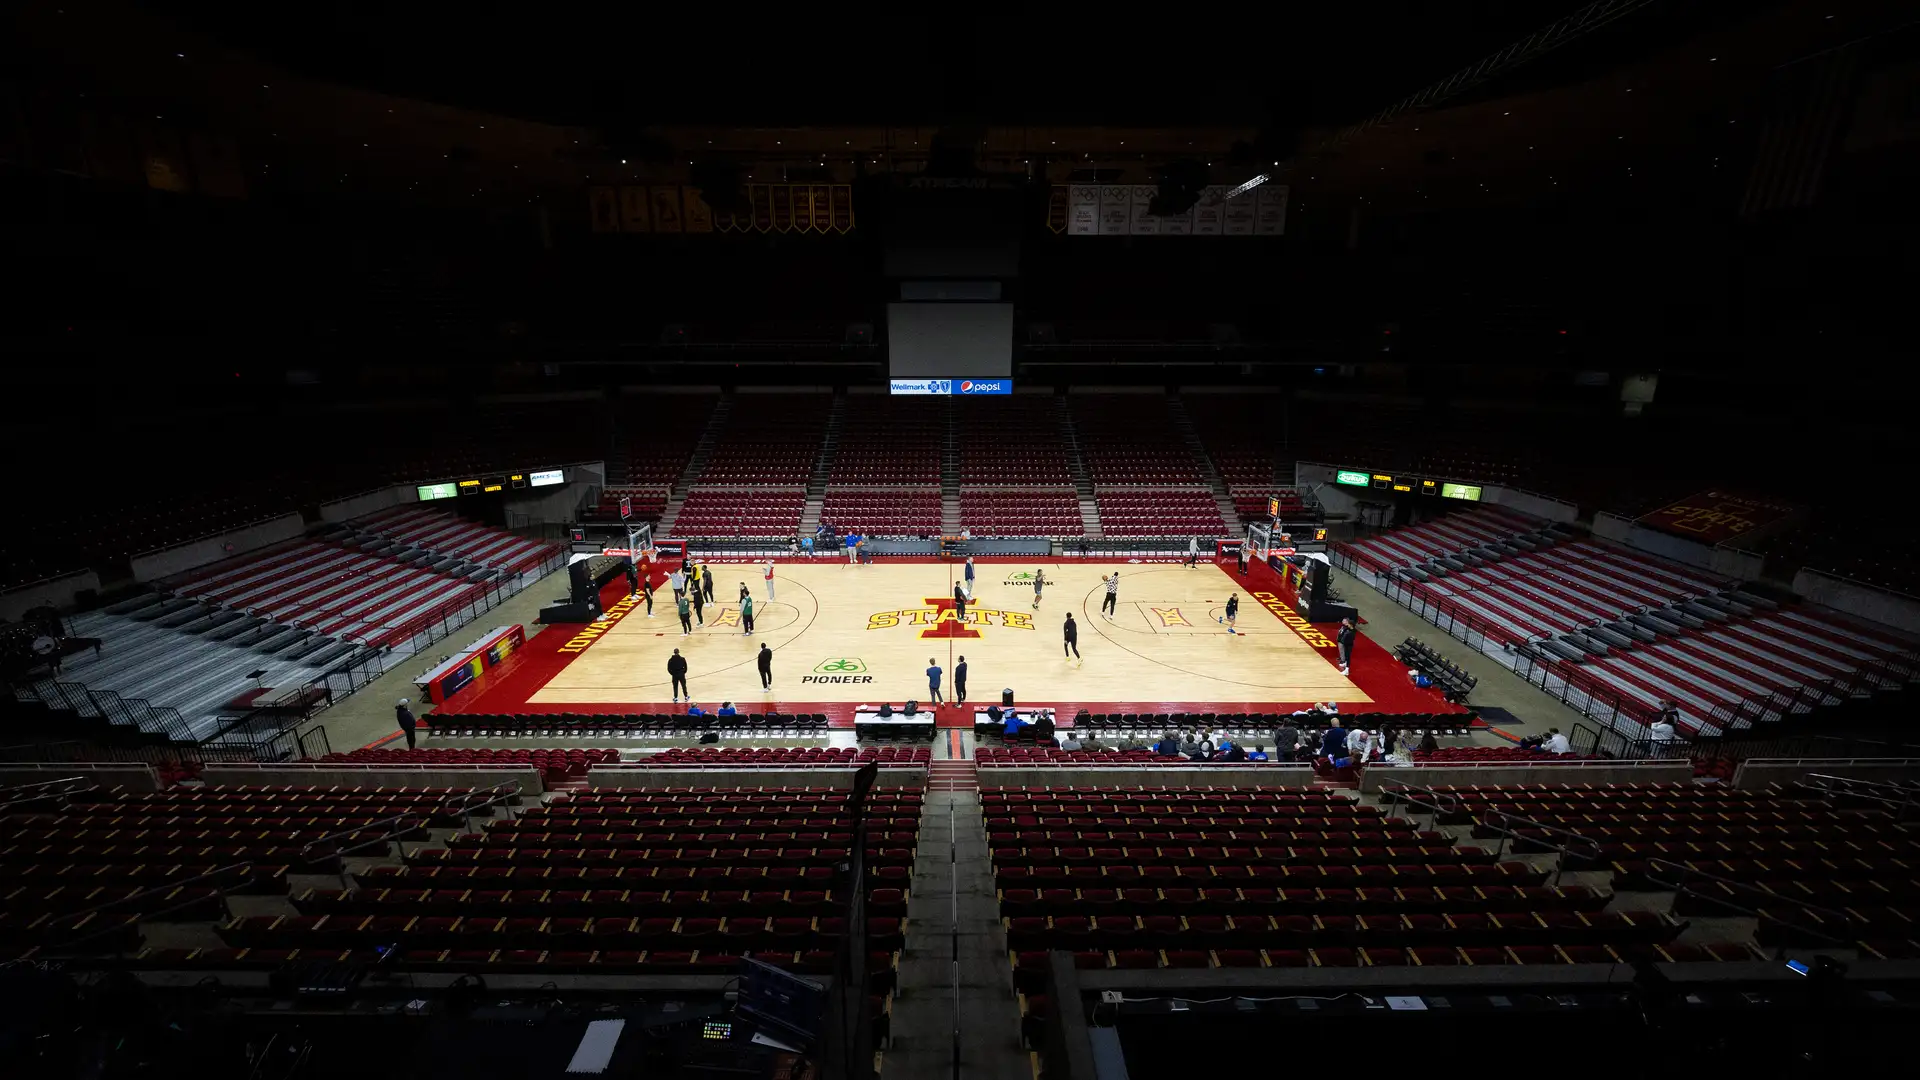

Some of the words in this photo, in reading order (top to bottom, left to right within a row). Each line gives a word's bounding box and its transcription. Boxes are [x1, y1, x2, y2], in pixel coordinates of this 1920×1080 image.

[891, 383, 925, 391] Wellmark
[974, 382, 1001, 392] pepsi
[867, 608, 1035, 631] STATE
[1253, 591, 1337, 648] CYCLONES
[557, 620, 614, 653] IOWA
[802, 675, 873, 684] PIONEER
